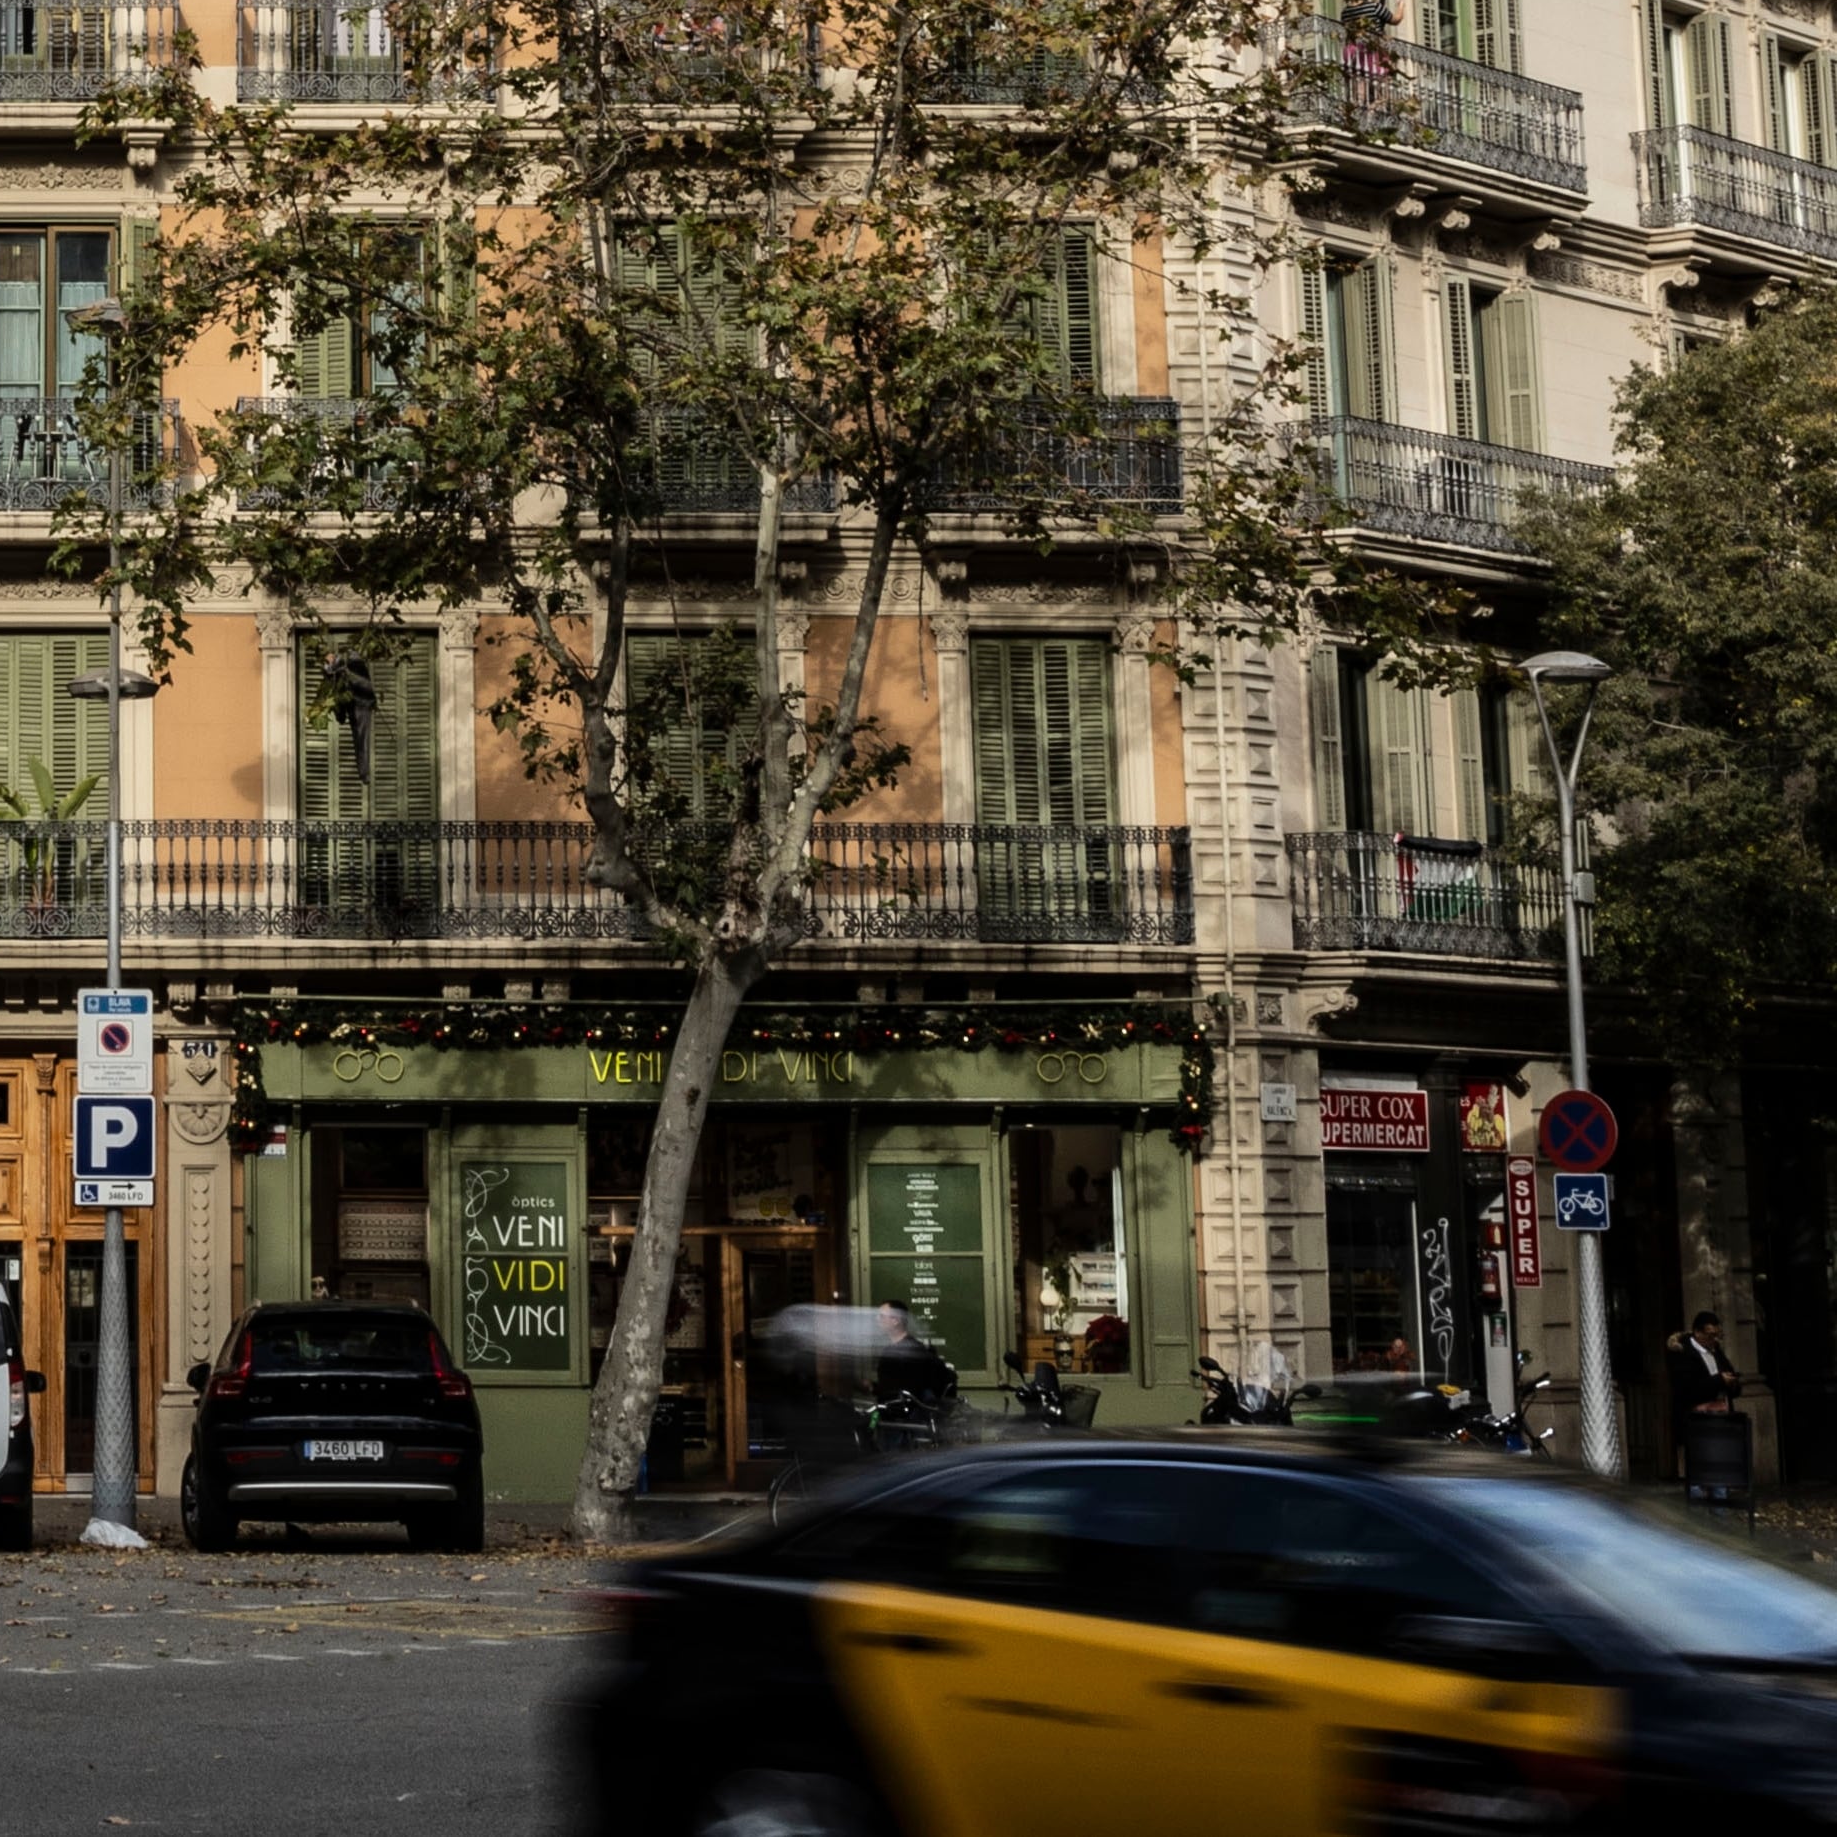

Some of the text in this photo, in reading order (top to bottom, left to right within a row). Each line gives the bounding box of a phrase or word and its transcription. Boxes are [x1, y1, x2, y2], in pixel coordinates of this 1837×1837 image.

[589, 1048, 853, 1083] VENI DI VINCI
[1320, 1094, 1415, 1120] SUPER COX
[91, 1106, 138, 1168] P
[1322, 1122, 1425, 1146] UPERMERCAT
[512, 1196, 555, 1209] òptics
[492, 1215, 564, 1247] VENI
[1515, 1180, 1535, 1274] SUPER
[492, 1260, 564, 1292] VIDI
[492, 1305, 564, 1337] VINCI
[315, 1442, 380, 1456] 3460 LFD
